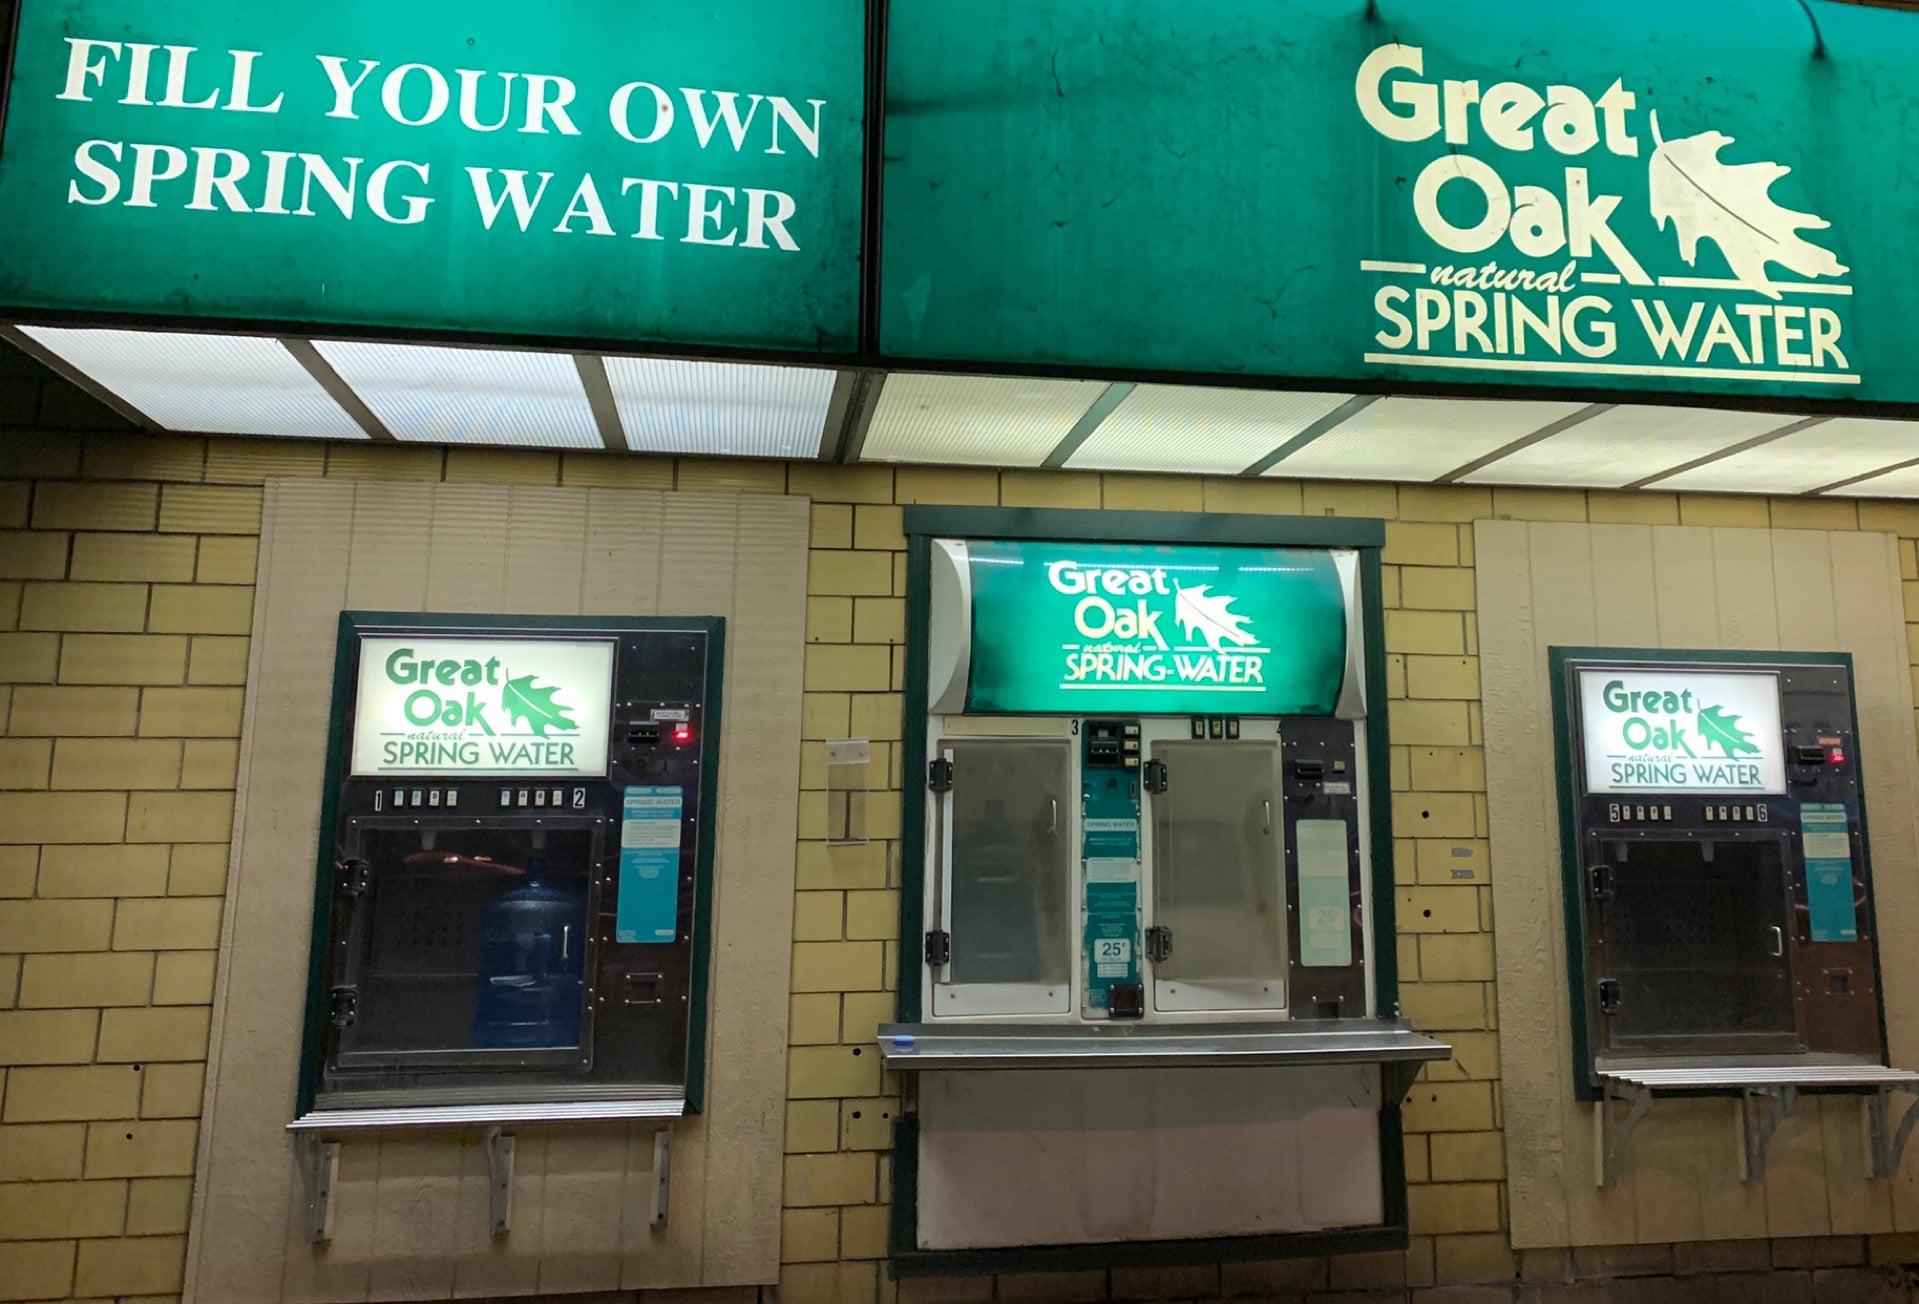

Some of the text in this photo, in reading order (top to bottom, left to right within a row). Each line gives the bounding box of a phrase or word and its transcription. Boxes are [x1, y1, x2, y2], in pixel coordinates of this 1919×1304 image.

[56, 37, 826, 158] FILL YOUR OWN
[1355, 43, 1638, 157] Great
[68, 139, 801, 252] SPRING WATER
[1413, 154, 1655, 286] Oak
[1430, 259, 1577, 294] natural
[1375, 285, 1849, 369] SPRING WATER
[1048, 560, 1171, 595] Great
[1074, 596, 1170, 650] Oak
[1083, 641, 1142, 654] natural
[385, 648, 500, 686] Great
[404, 689, 496, 736] Oak
[1603, 680, 1692, 713] Great
[407, 729, 467, 741] natural
[1071, 719, 1079, 735] 3
[1622, 717, 1697, 758] Oak
[383, 741, 575, 765] SPRING WATER
[1612, 763, 1761, 785] SPRING WATER
[574, 789, 584, 808] 2
[1610, 805, 1619, 821] 5
[1758, 805, 1766, 821] 6
